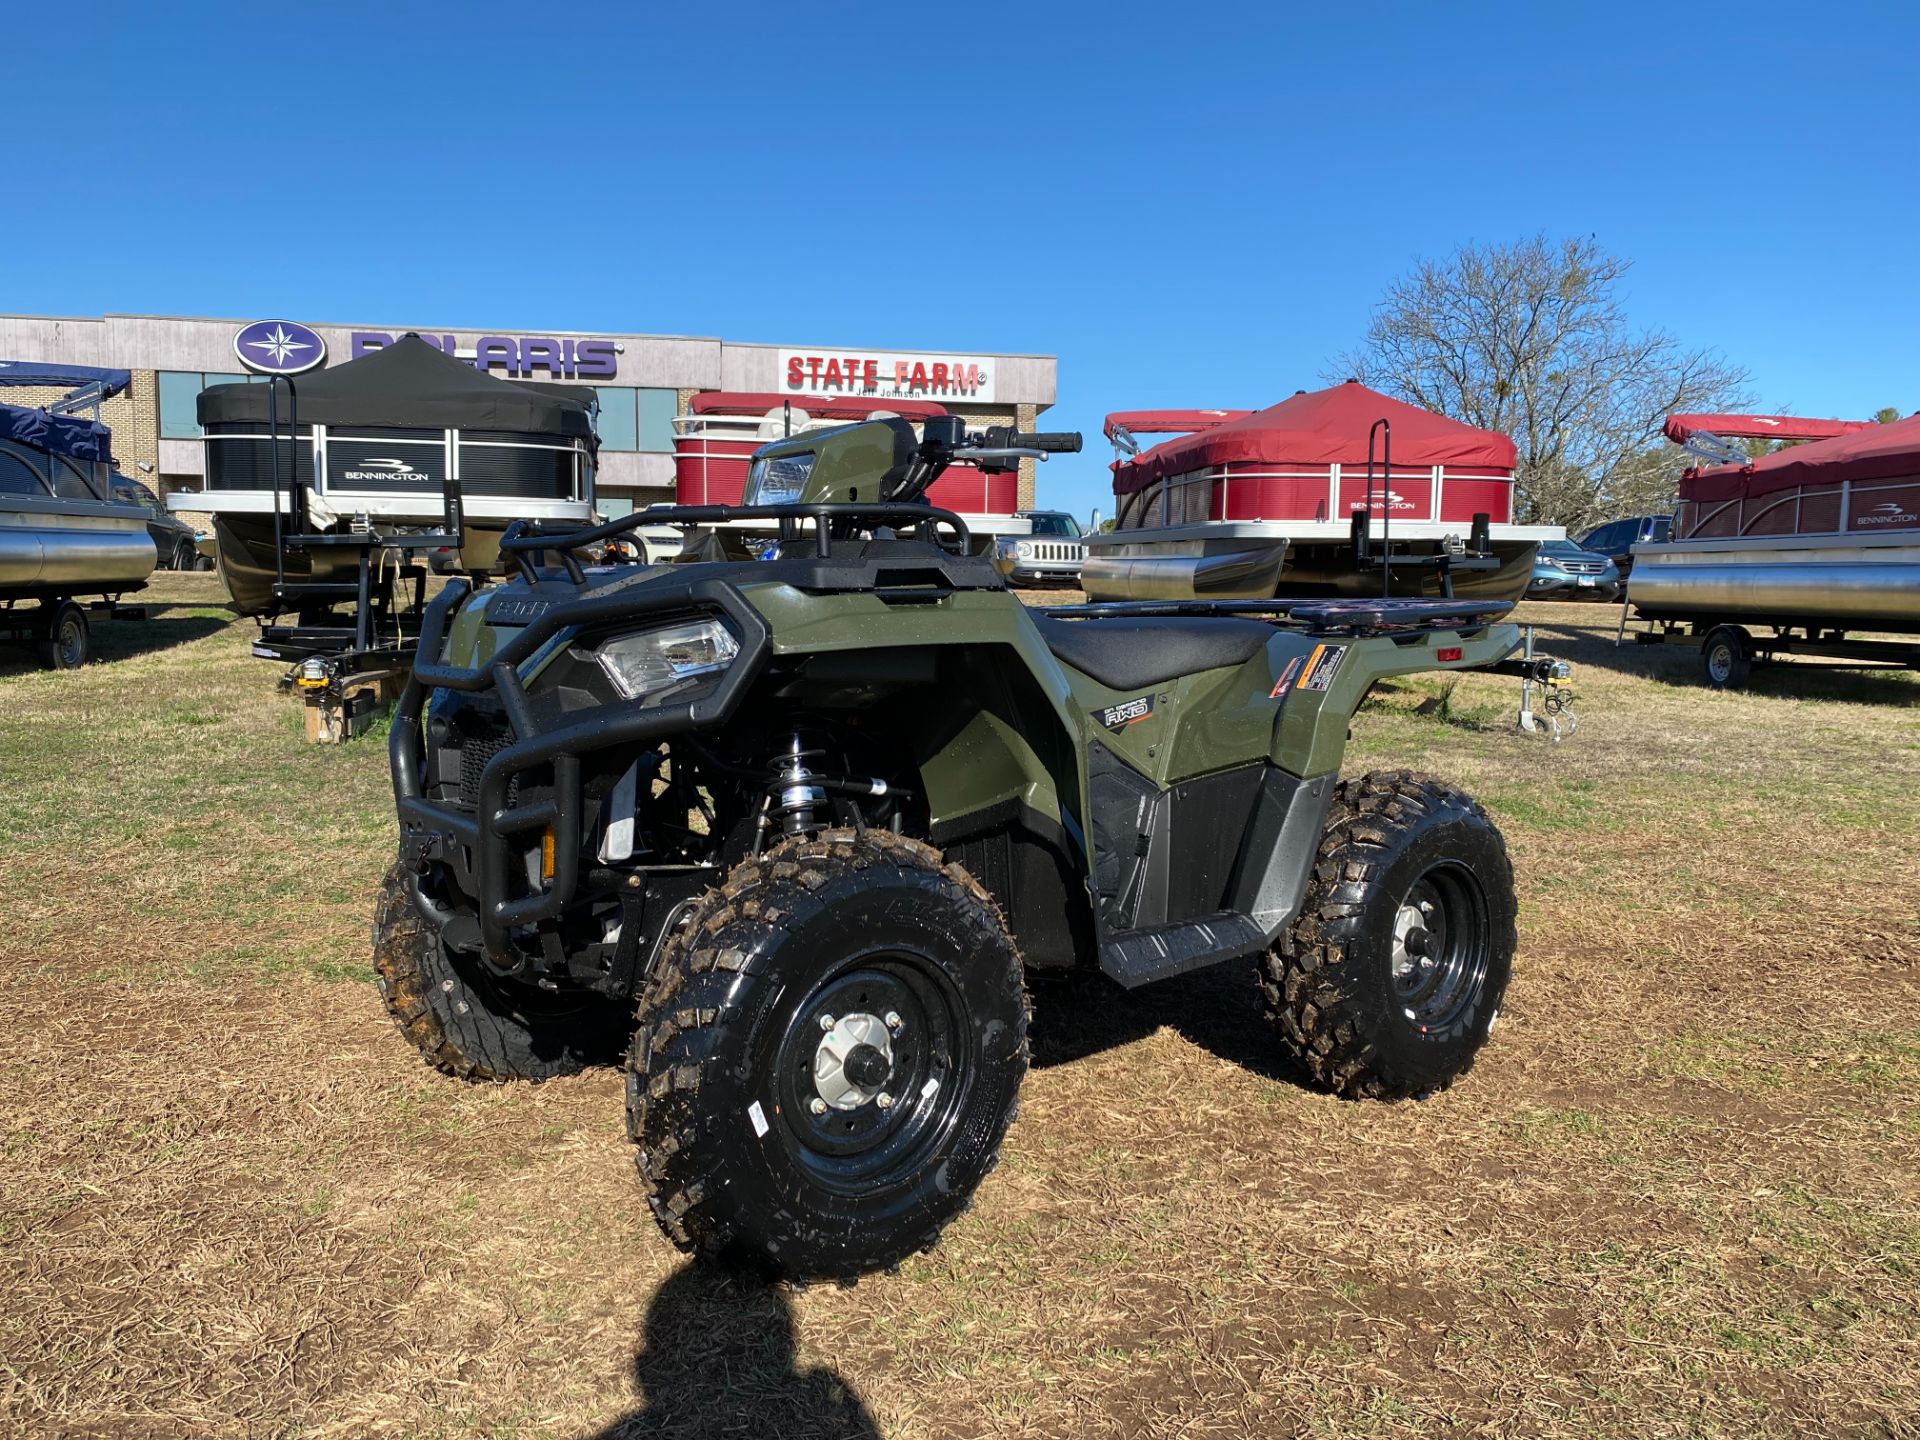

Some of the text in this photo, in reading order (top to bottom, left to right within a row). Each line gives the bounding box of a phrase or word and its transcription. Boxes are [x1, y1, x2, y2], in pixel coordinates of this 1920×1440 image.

[351, 333, 617, 376] PLARIS
[787, 356, 879, 389] STATE
[856, 387, 921, 399] Jeff Johnson
[344, 471, 429, 481] BENNINGTON
[1857, 514, 1918, 525] BENNINGTON
[1105, 703, 1148, 727] AWD
